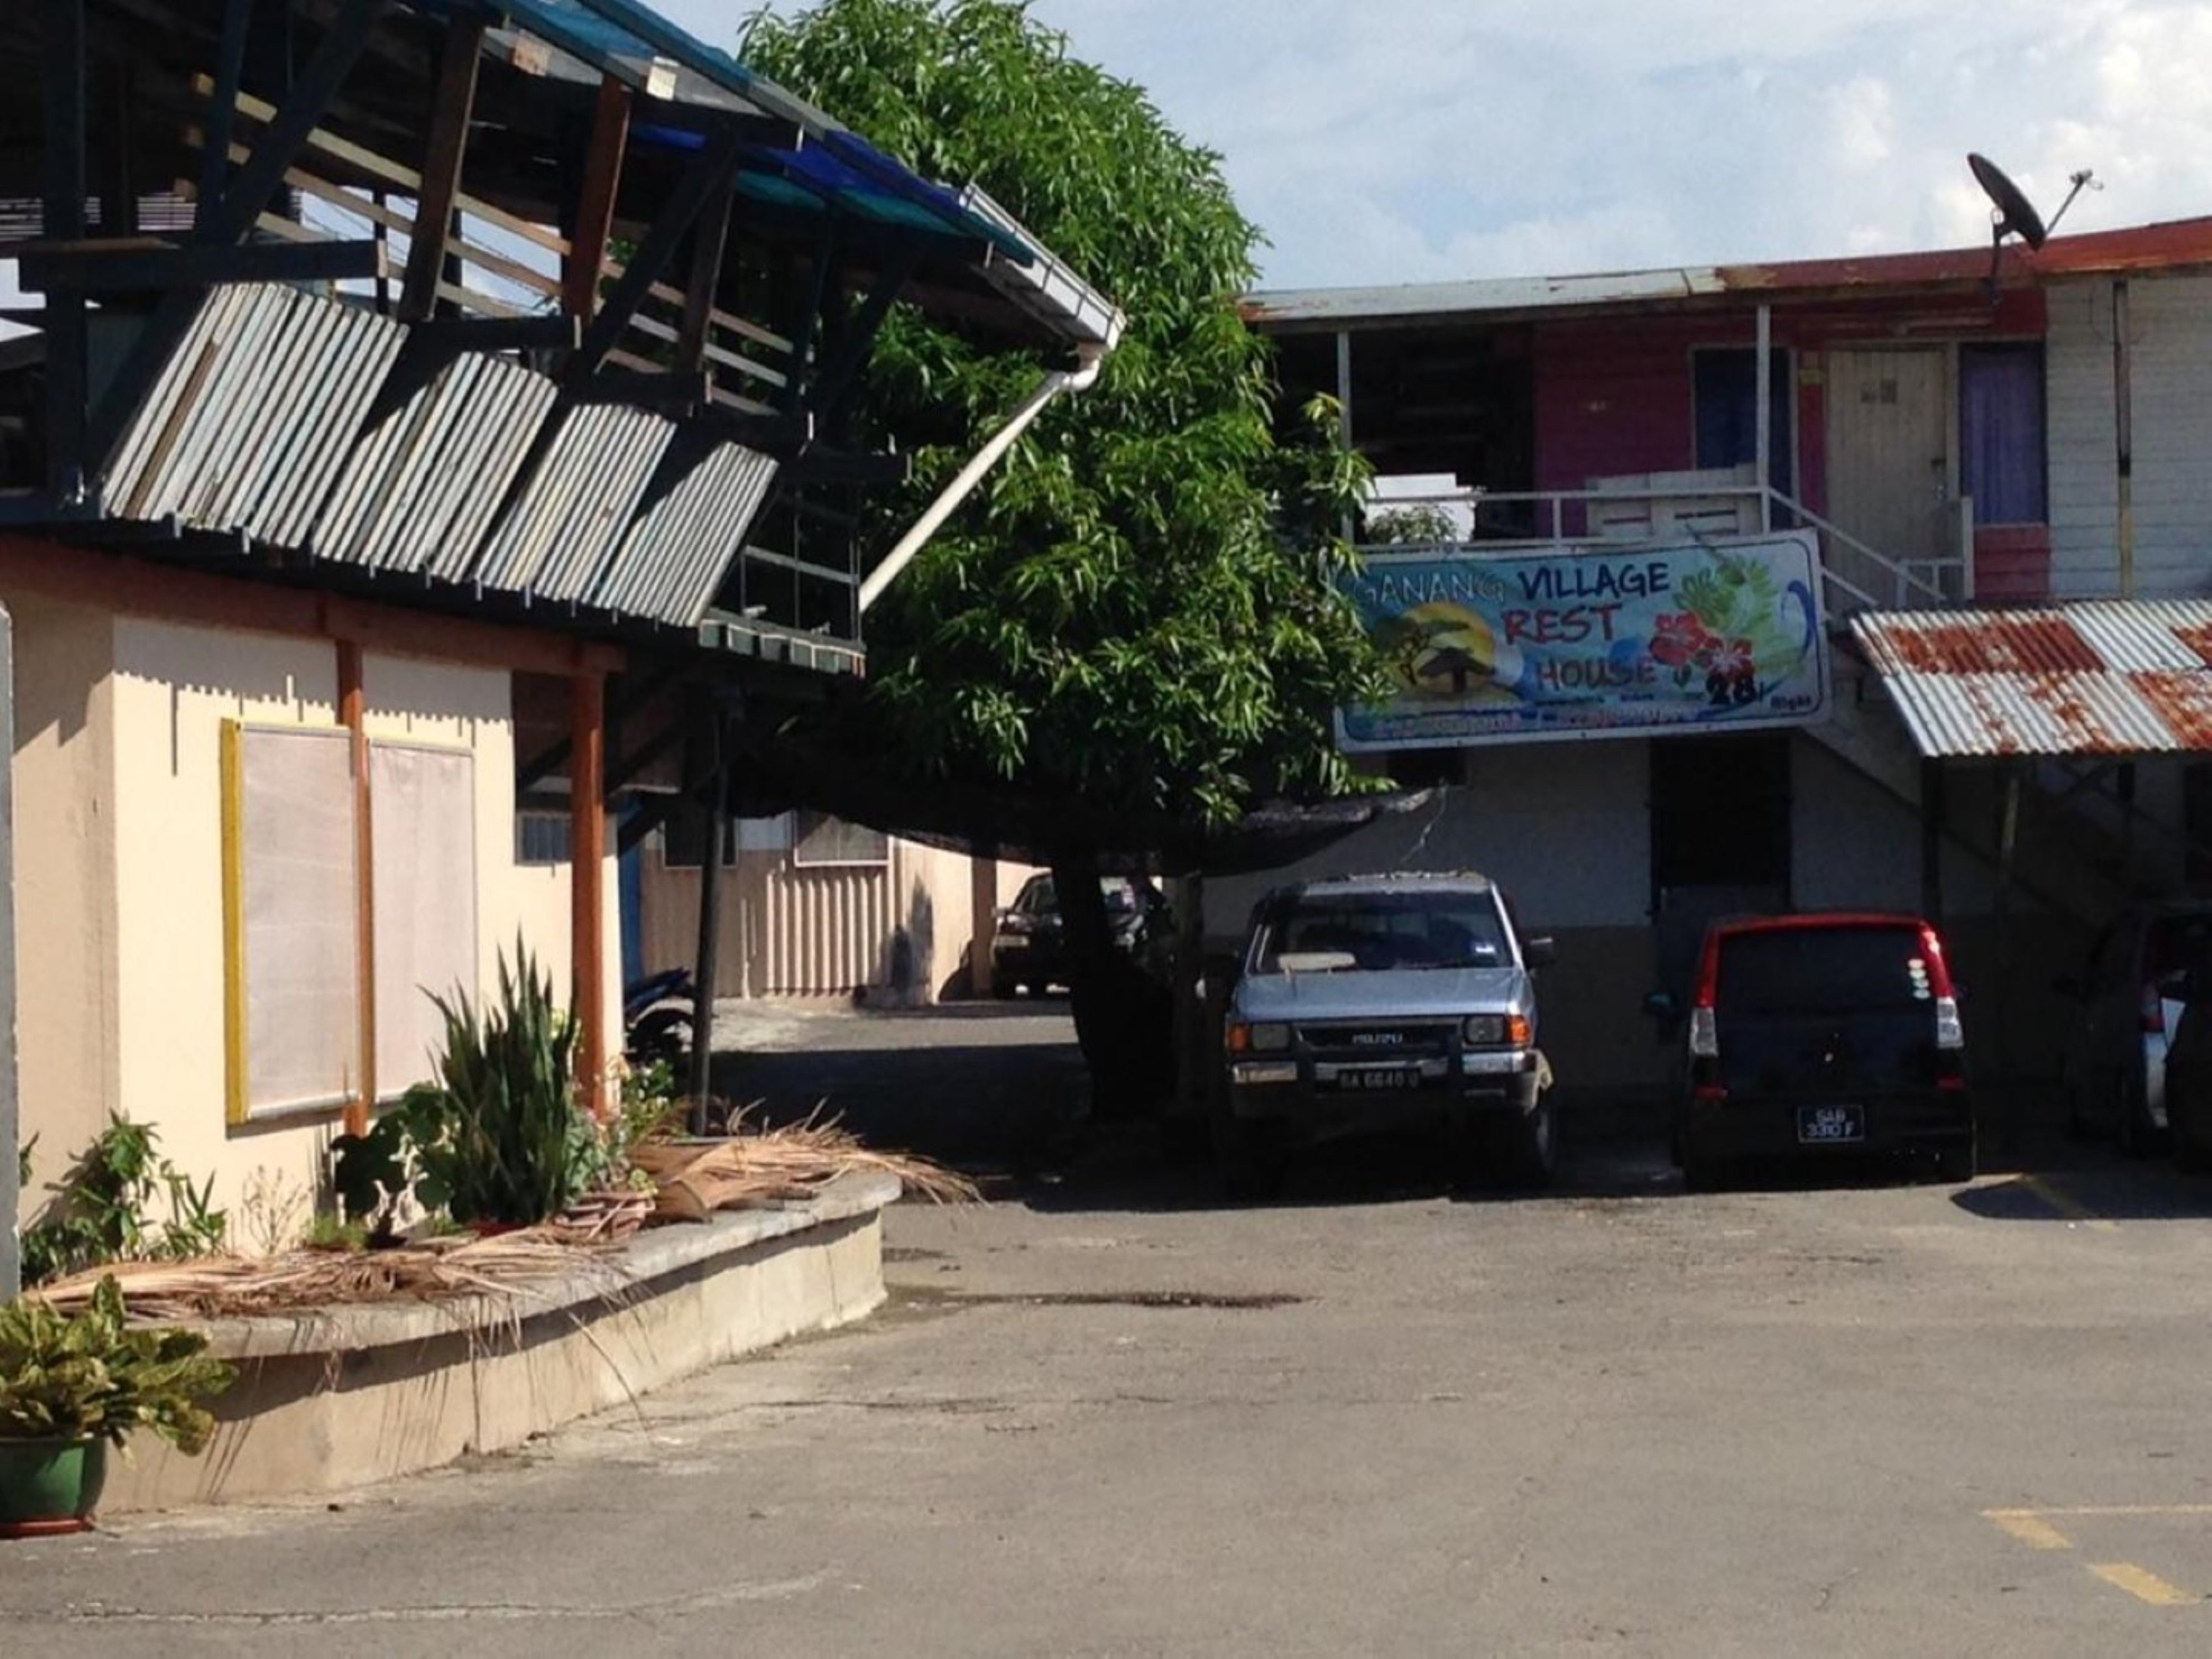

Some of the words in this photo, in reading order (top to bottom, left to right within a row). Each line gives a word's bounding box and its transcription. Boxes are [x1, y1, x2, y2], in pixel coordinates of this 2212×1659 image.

[1517, 562, 1670, 601] VILLAGE
[1501, 602, 1623, 645] REST
[1536, 656, 1658, 691] HOUSE
